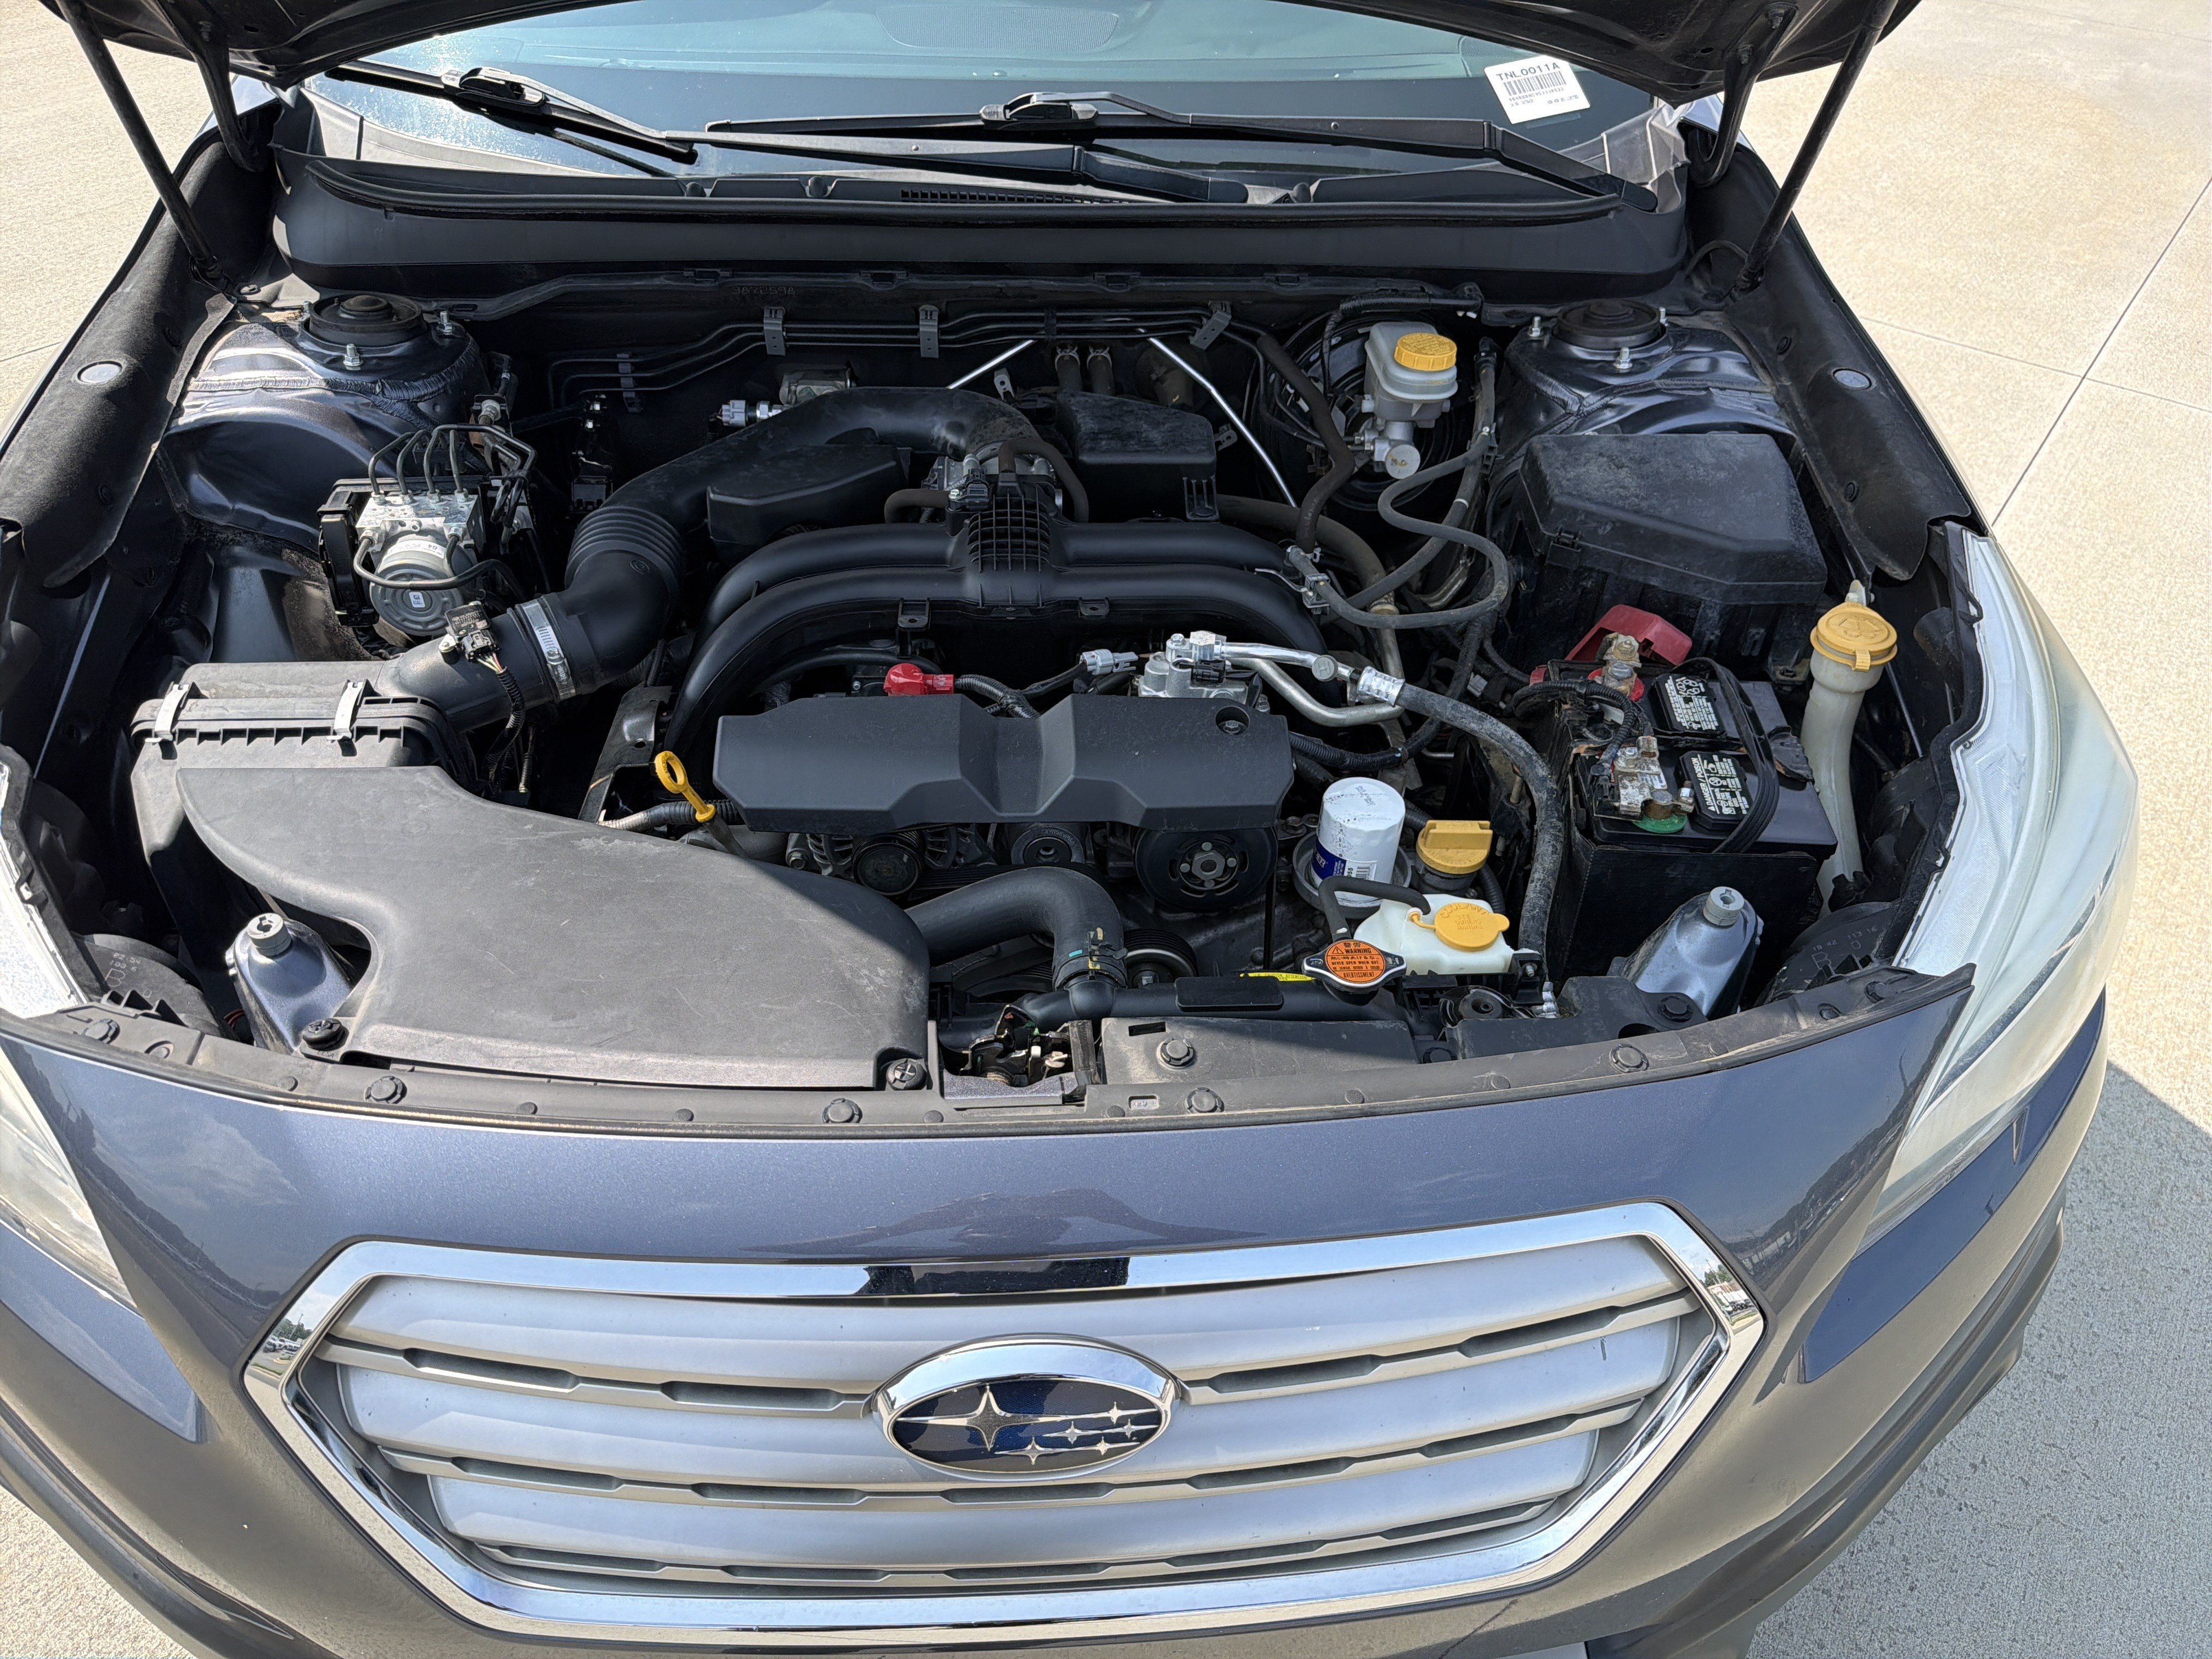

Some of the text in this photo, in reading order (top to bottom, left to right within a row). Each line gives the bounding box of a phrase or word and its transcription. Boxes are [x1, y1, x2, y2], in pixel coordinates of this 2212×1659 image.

[1496, 61, 1560, 81] TNL0011A
[1691, 757, 1705, 778] POISON
[1699, 782, 1715, 806] DANGER
[1440, 903, 1490, 918] COOLANT
